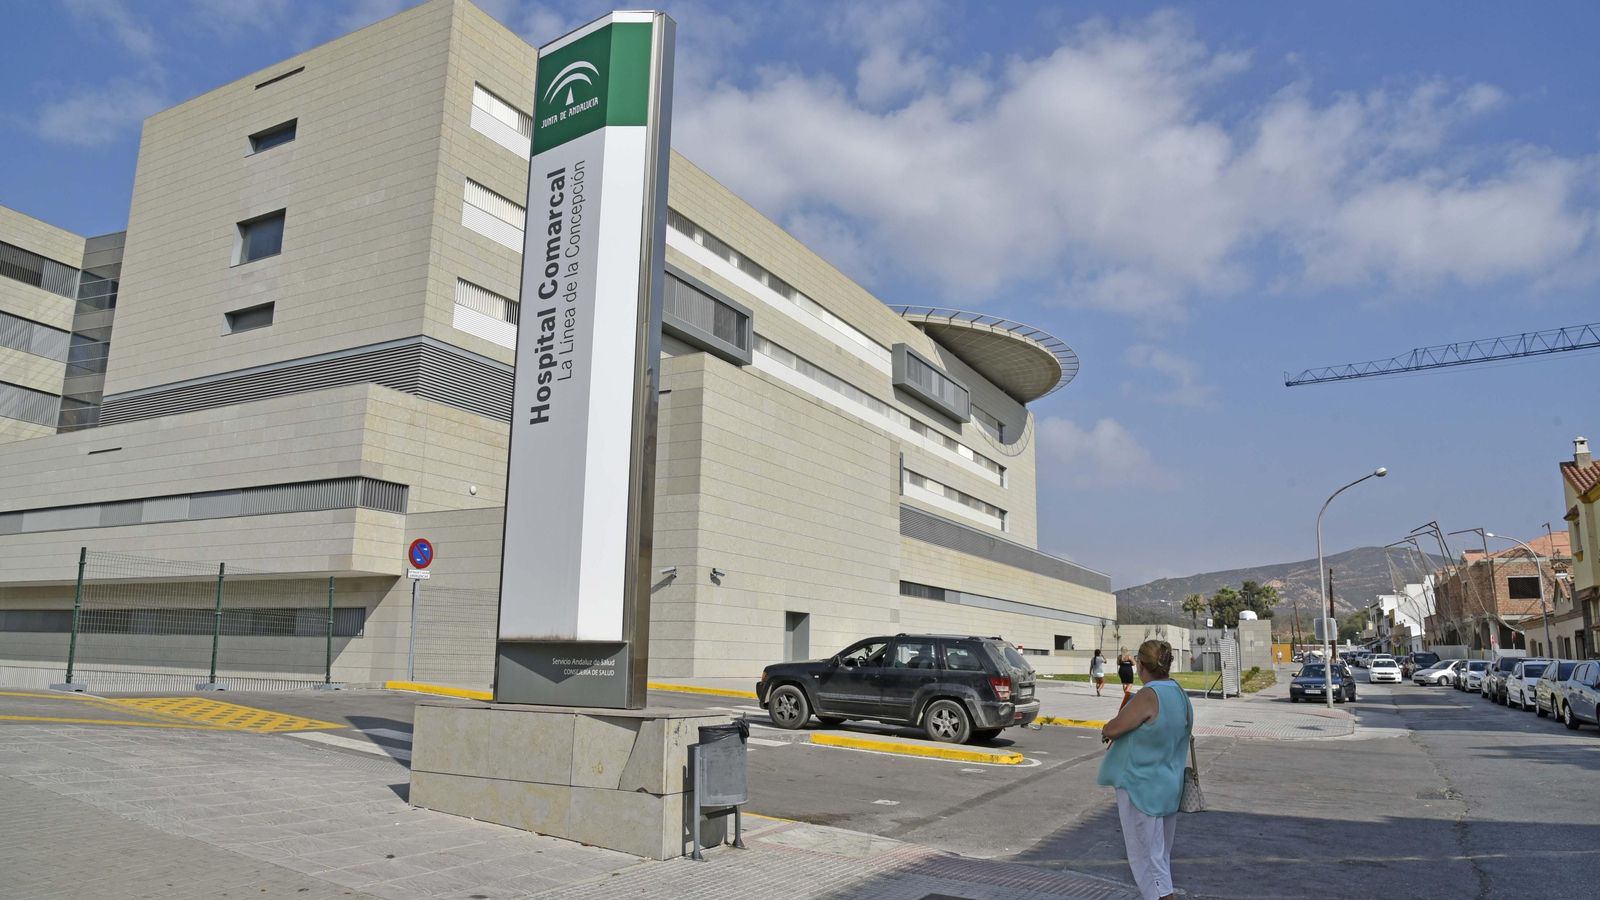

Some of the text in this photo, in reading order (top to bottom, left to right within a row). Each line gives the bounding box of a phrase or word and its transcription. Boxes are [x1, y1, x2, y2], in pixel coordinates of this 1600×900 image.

[541, 115, 558, 129] JUNTA
[560, 110, 567, 121] DE
[557, 160, 586, 381] La Línea de la Concepción
[529, 167, 566, 425] Hospital Comarcal
[552, 657, 571, 665] Servicio
[571, 658, 593, 666] Andaluz
[592, 668, 600, 676] DE
[599, 668, 615, 677] SALUD
